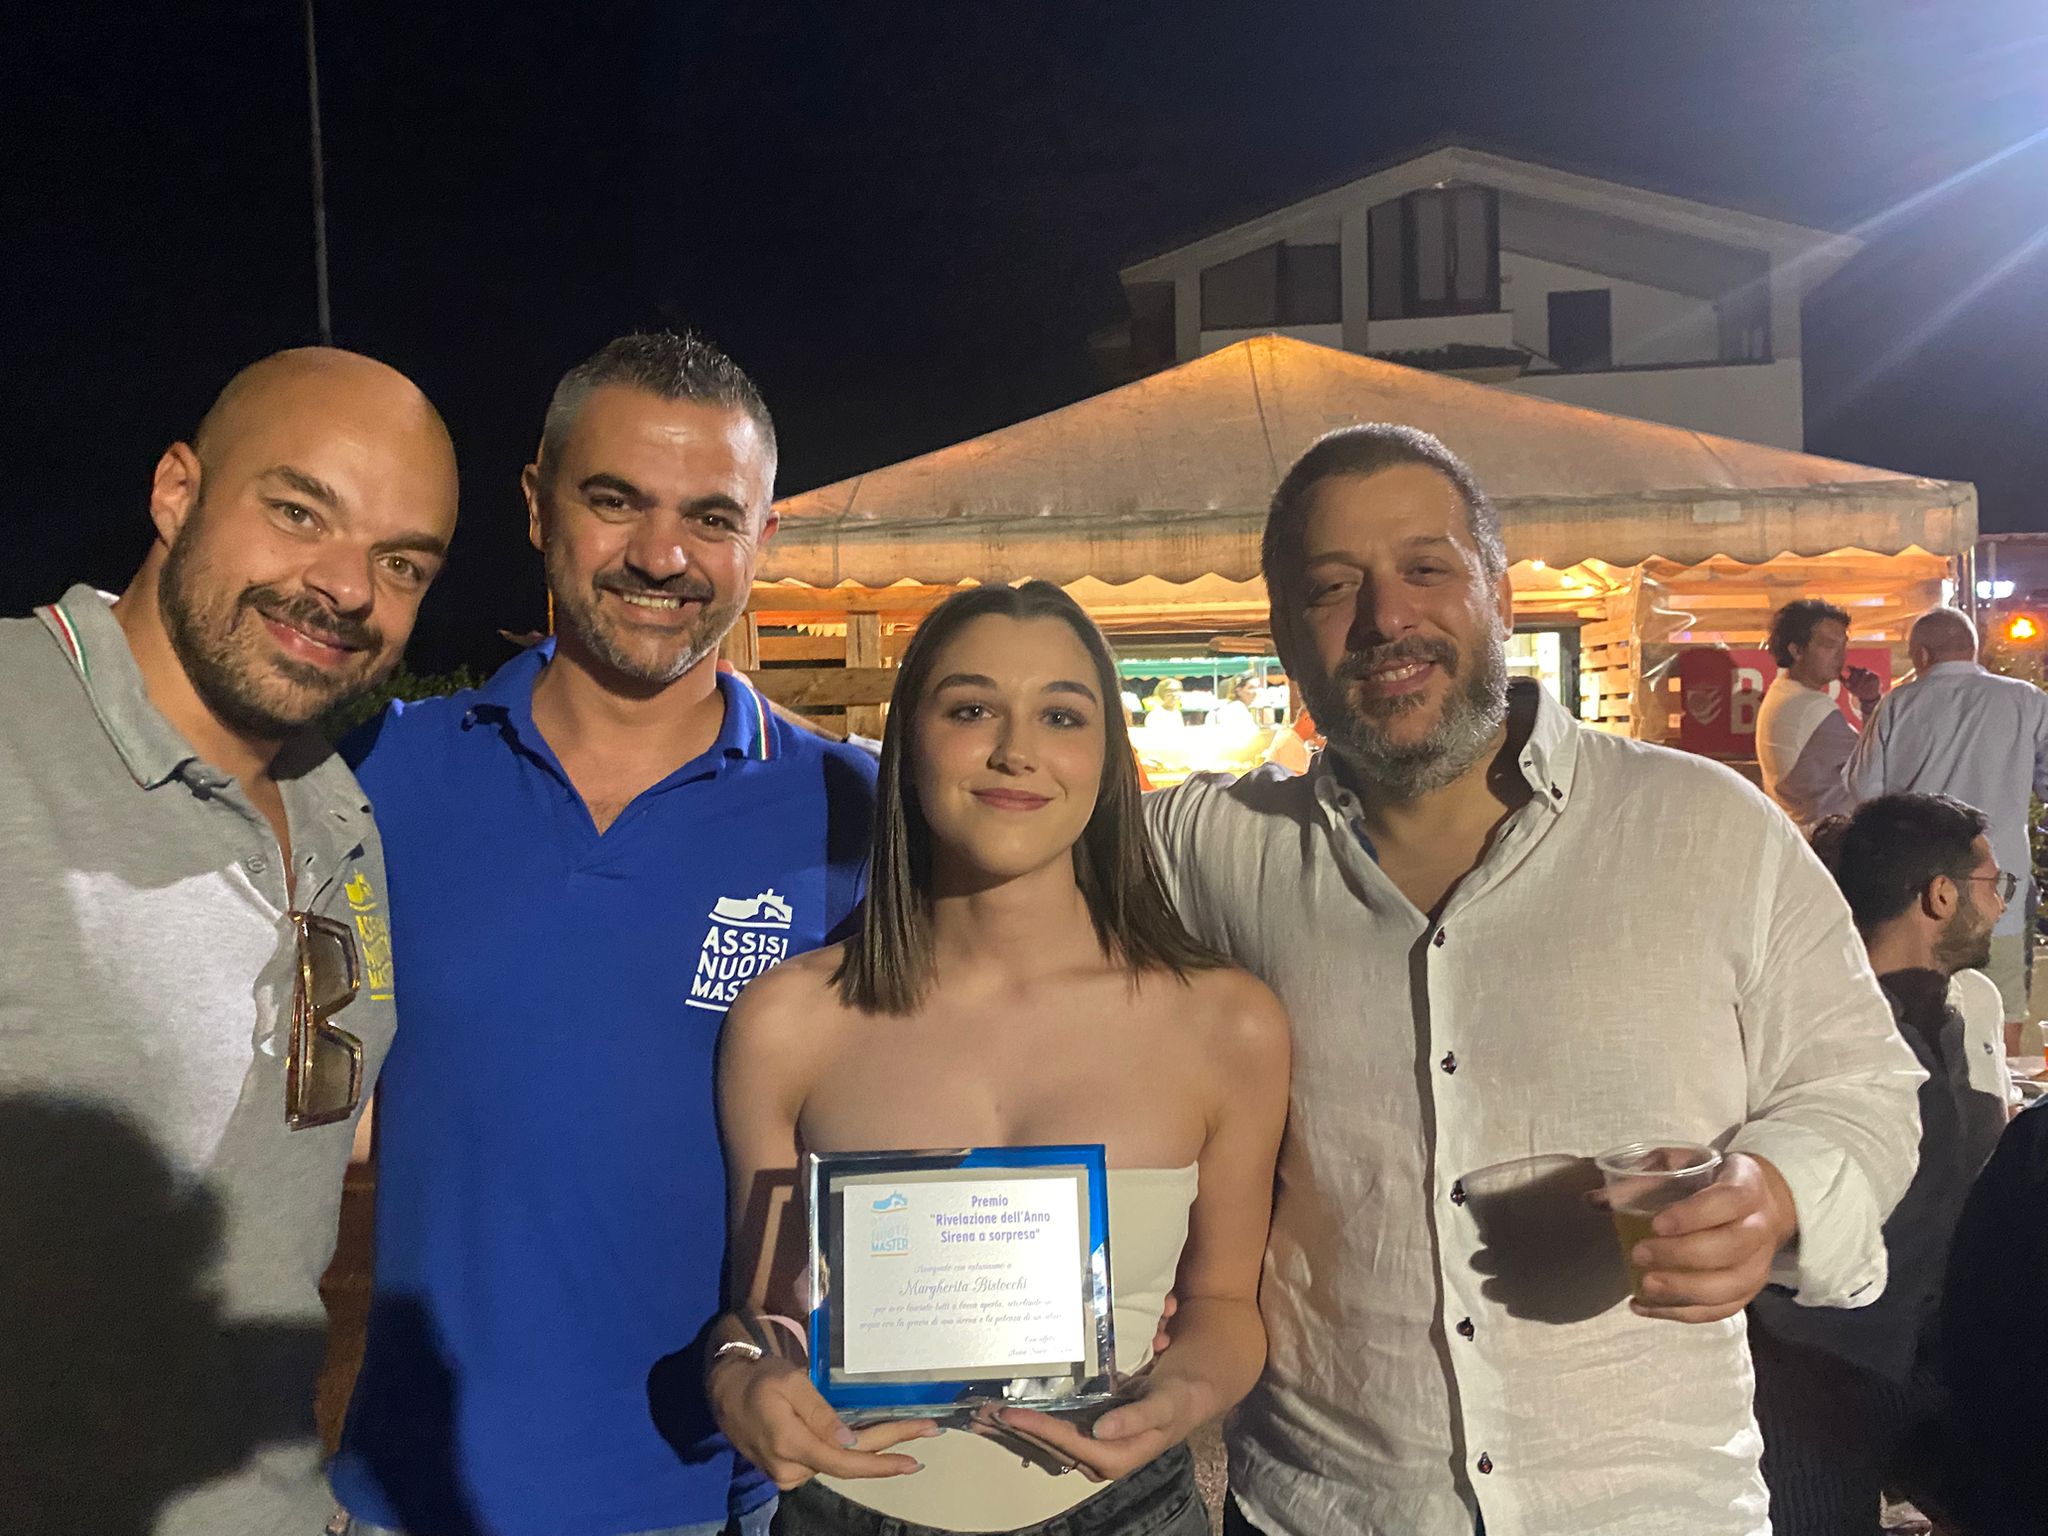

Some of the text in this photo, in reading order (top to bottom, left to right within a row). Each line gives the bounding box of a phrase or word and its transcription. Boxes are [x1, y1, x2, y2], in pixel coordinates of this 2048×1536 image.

[702, 926, 788, 960] ASSISI
[691, 974, 752, 1001] MAS
[971, 1194, 1009, 1208] Premio
[930, 1210, 1051, 1227] "Rivelazione dell'Anno
[940, 1229, 976, 1244] Sirena
[988, 1227, 1041, 1243] sorpresa"
[871, 1238, 909, 1252] MASTER
[898, 1278, 969, 1300] Margherita
